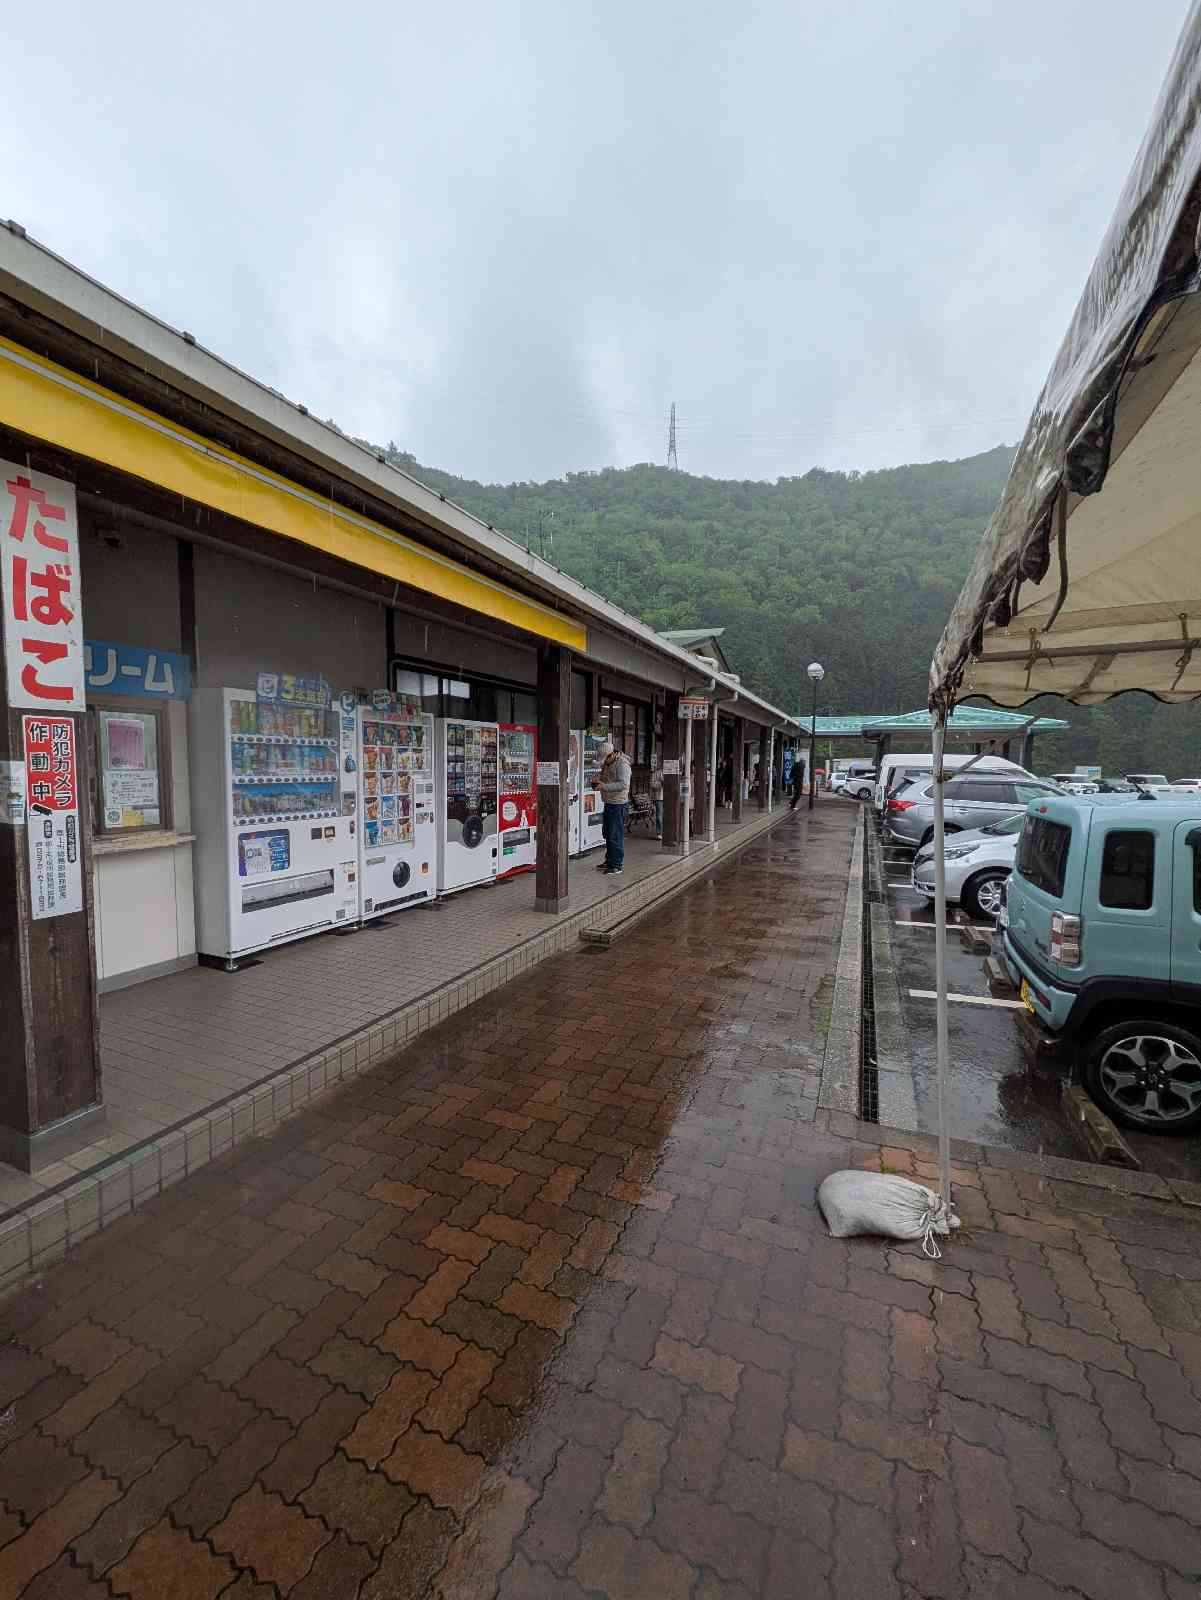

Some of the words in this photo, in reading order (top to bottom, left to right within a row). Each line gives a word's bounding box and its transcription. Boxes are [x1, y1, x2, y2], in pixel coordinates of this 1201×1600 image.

[6, 475, 74, 703] たばこ
[83, 645, 175, 694] リーム
[29, 722, 52, 801] 作動中
[52, 724, 73, 807] 防犯カメラ
